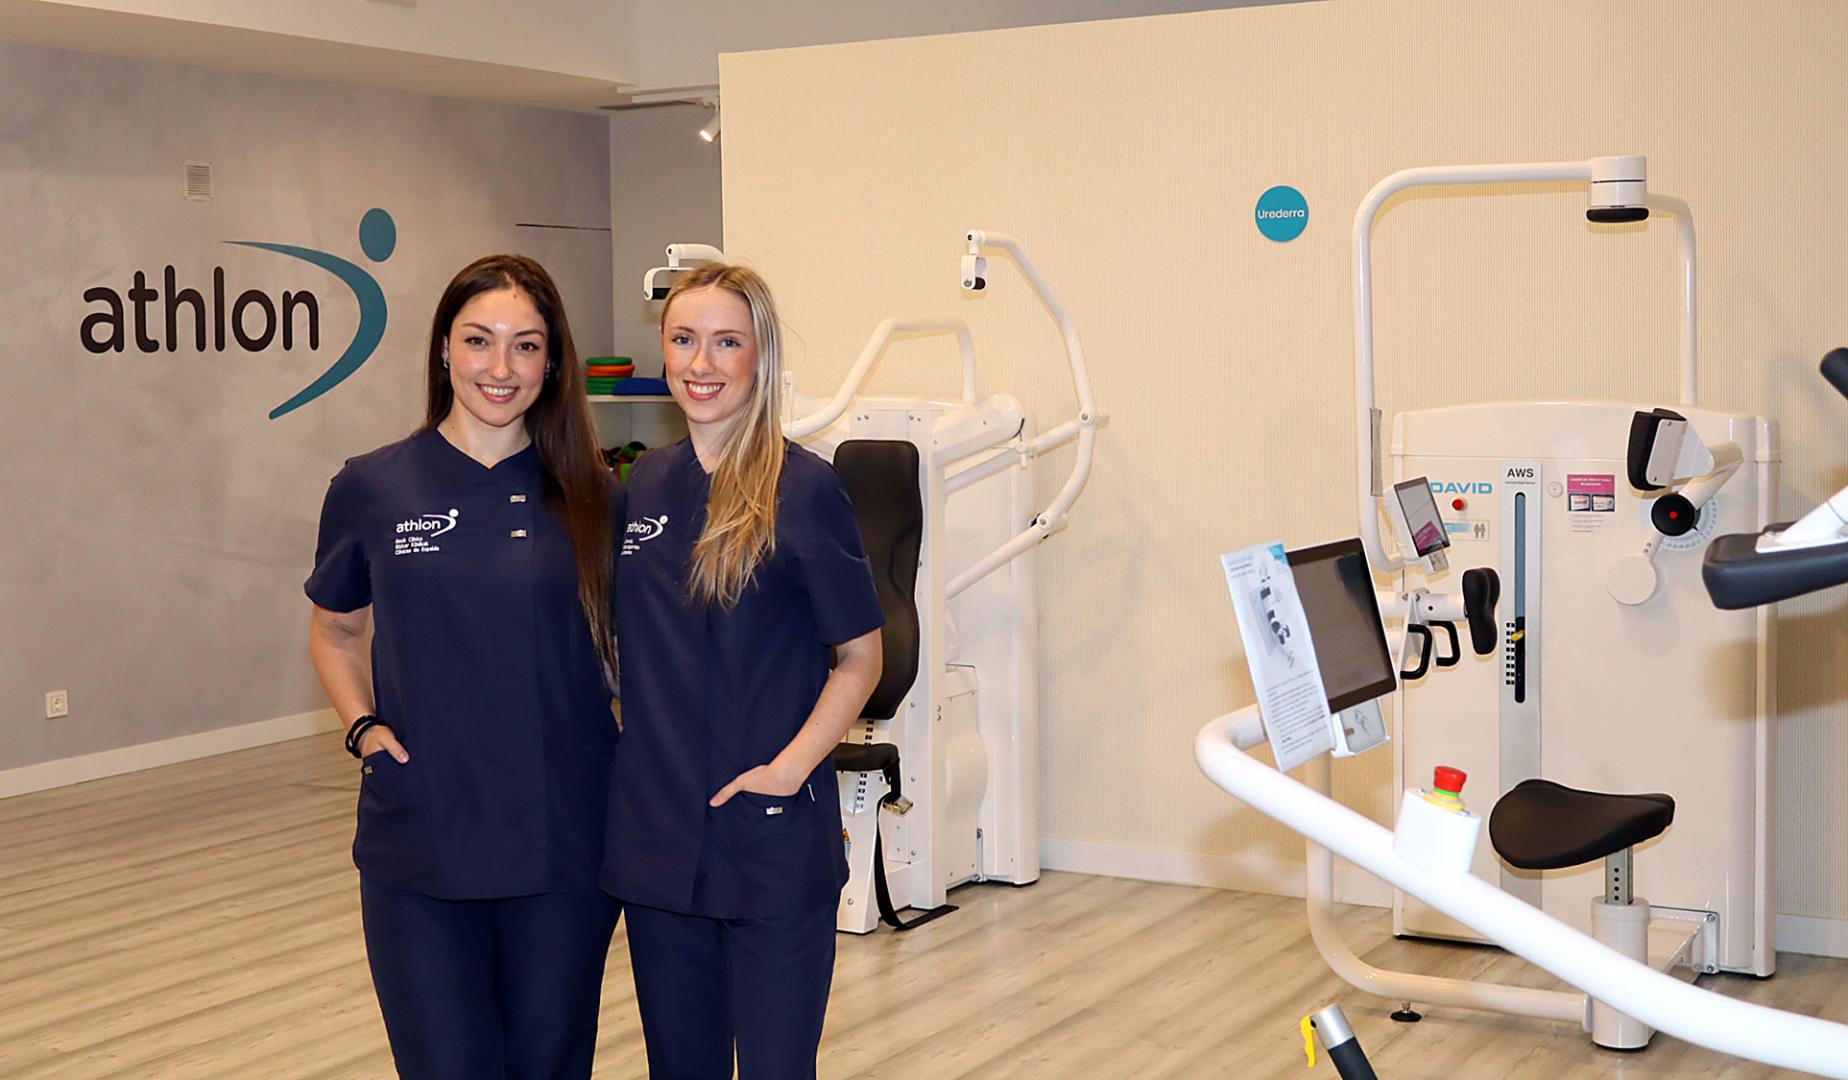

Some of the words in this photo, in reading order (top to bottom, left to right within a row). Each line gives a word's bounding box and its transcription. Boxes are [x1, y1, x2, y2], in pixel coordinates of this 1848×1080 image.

[1257, 208, 1304, 219] Urederra
[80, 265, 319, 353] athlon
[1507, 468, 1534, 478] AWS
[1430, 481, 1493, 494] DAVID
[396, 518, 441, 533] athlon
